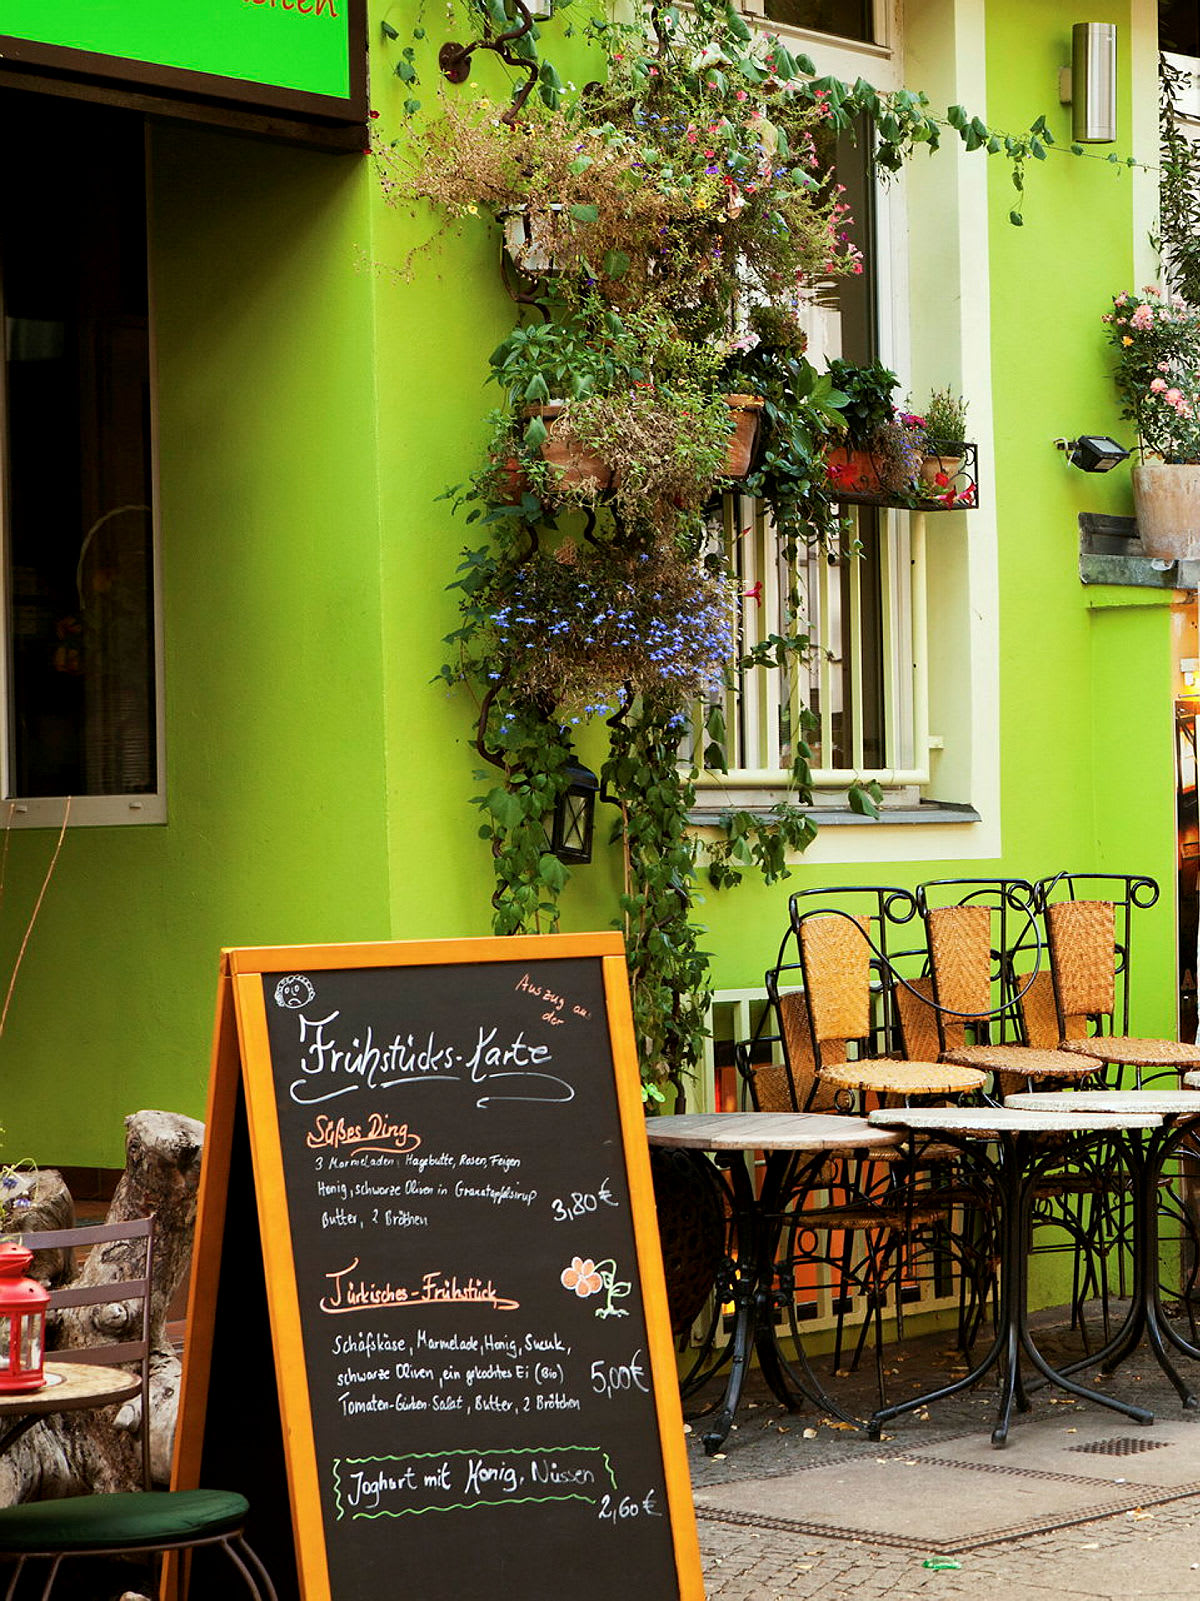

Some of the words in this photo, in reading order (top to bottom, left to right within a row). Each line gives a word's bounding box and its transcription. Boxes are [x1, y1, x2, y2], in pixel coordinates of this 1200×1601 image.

[541, 1009, 565, 1026] der
[307, 1115, 361, 1148] Süßes
[367, 1113, 410, 1147] Ding
[315, 1156, 324, 1170] 3
[405, 1179, 434, 1195] Oliven
[437, 1184, 448, 1195] in
[372, 1208, 379, 1223] 2
[337, 1368, 391, 1387] schwarze
[516, 1366, 529, 1379] Ei
[534, 1362, 564, 1385] (Bio)
[523, 1397, 531, 1411] 2
[347, 1467, 416, 1508] Joghurt
[423, 1462, 451, 1489] mit
[531, 1459, 594, 1485] Nüssen
